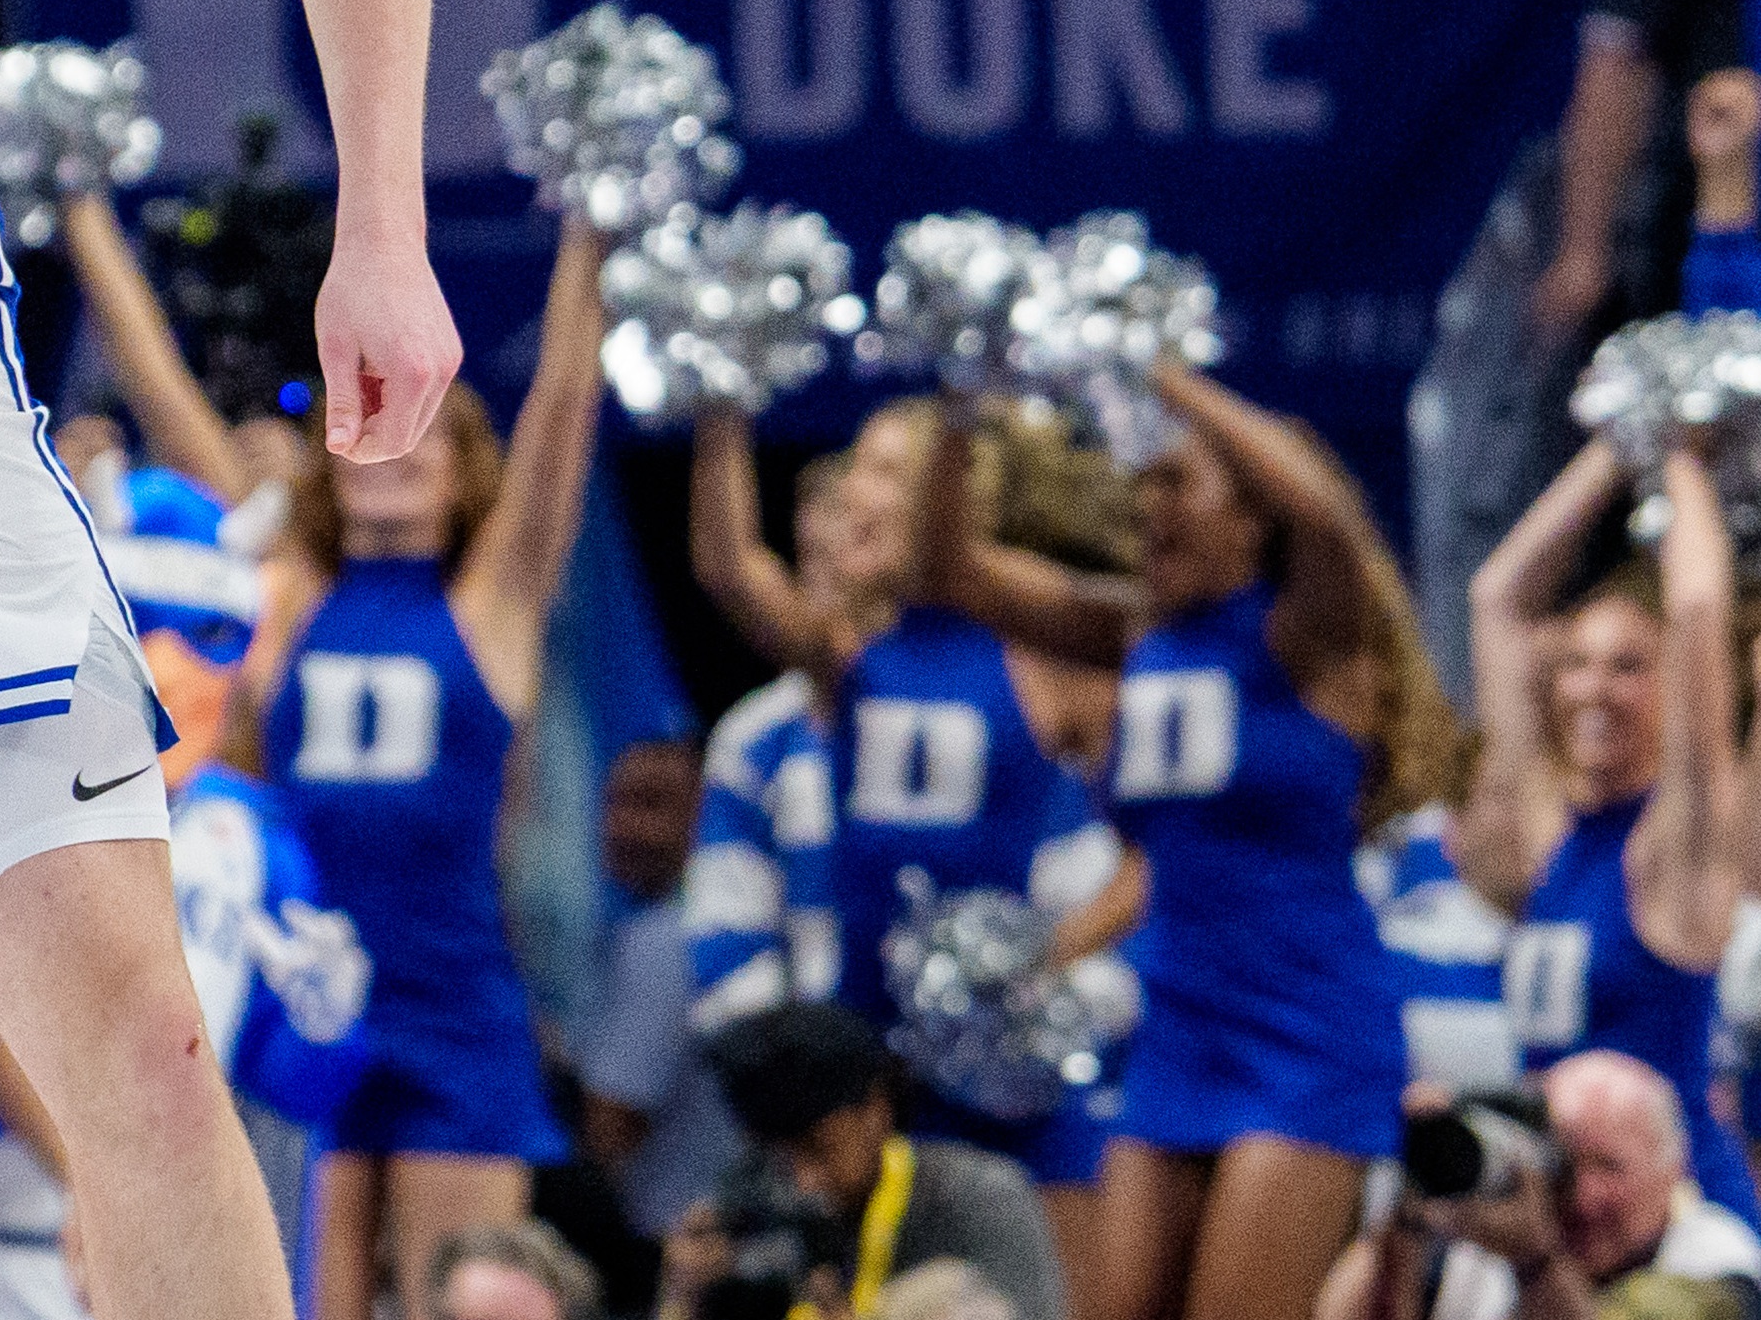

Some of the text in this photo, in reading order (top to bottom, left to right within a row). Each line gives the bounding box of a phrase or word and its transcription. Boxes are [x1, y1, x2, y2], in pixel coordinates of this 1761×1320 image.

[292, 651, 441, 783] D
[849, 696, 989, 828] D
[1118, 668, 1240, 800] D
